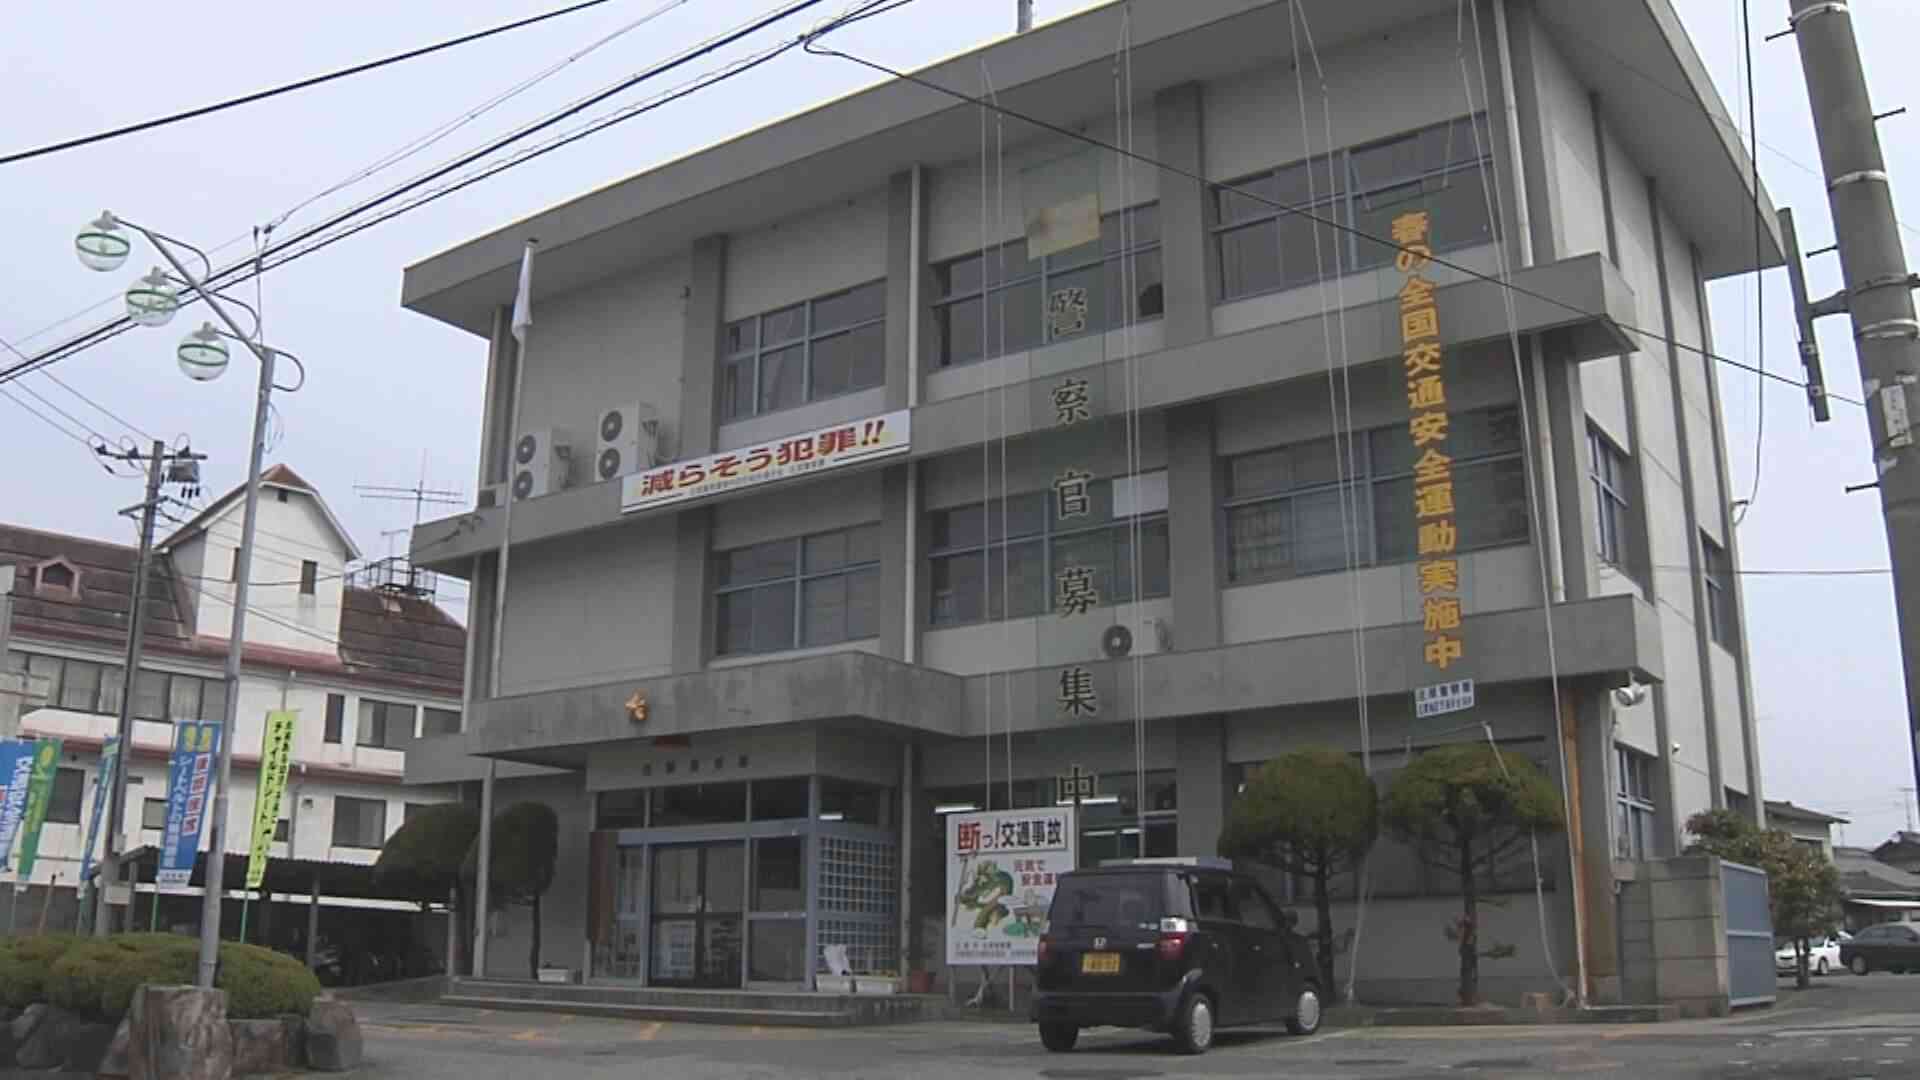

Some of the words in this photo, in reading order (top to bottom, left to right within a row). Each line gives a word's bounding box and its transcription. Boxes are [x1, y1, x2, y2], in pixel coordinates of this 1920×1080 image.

[1048, 287, 1098, 807] 警察官募集中
[1391, 211, 1462, 669] 春の全国交通安全運動実施中
[1022, 872, 1056, 887] 安全運
